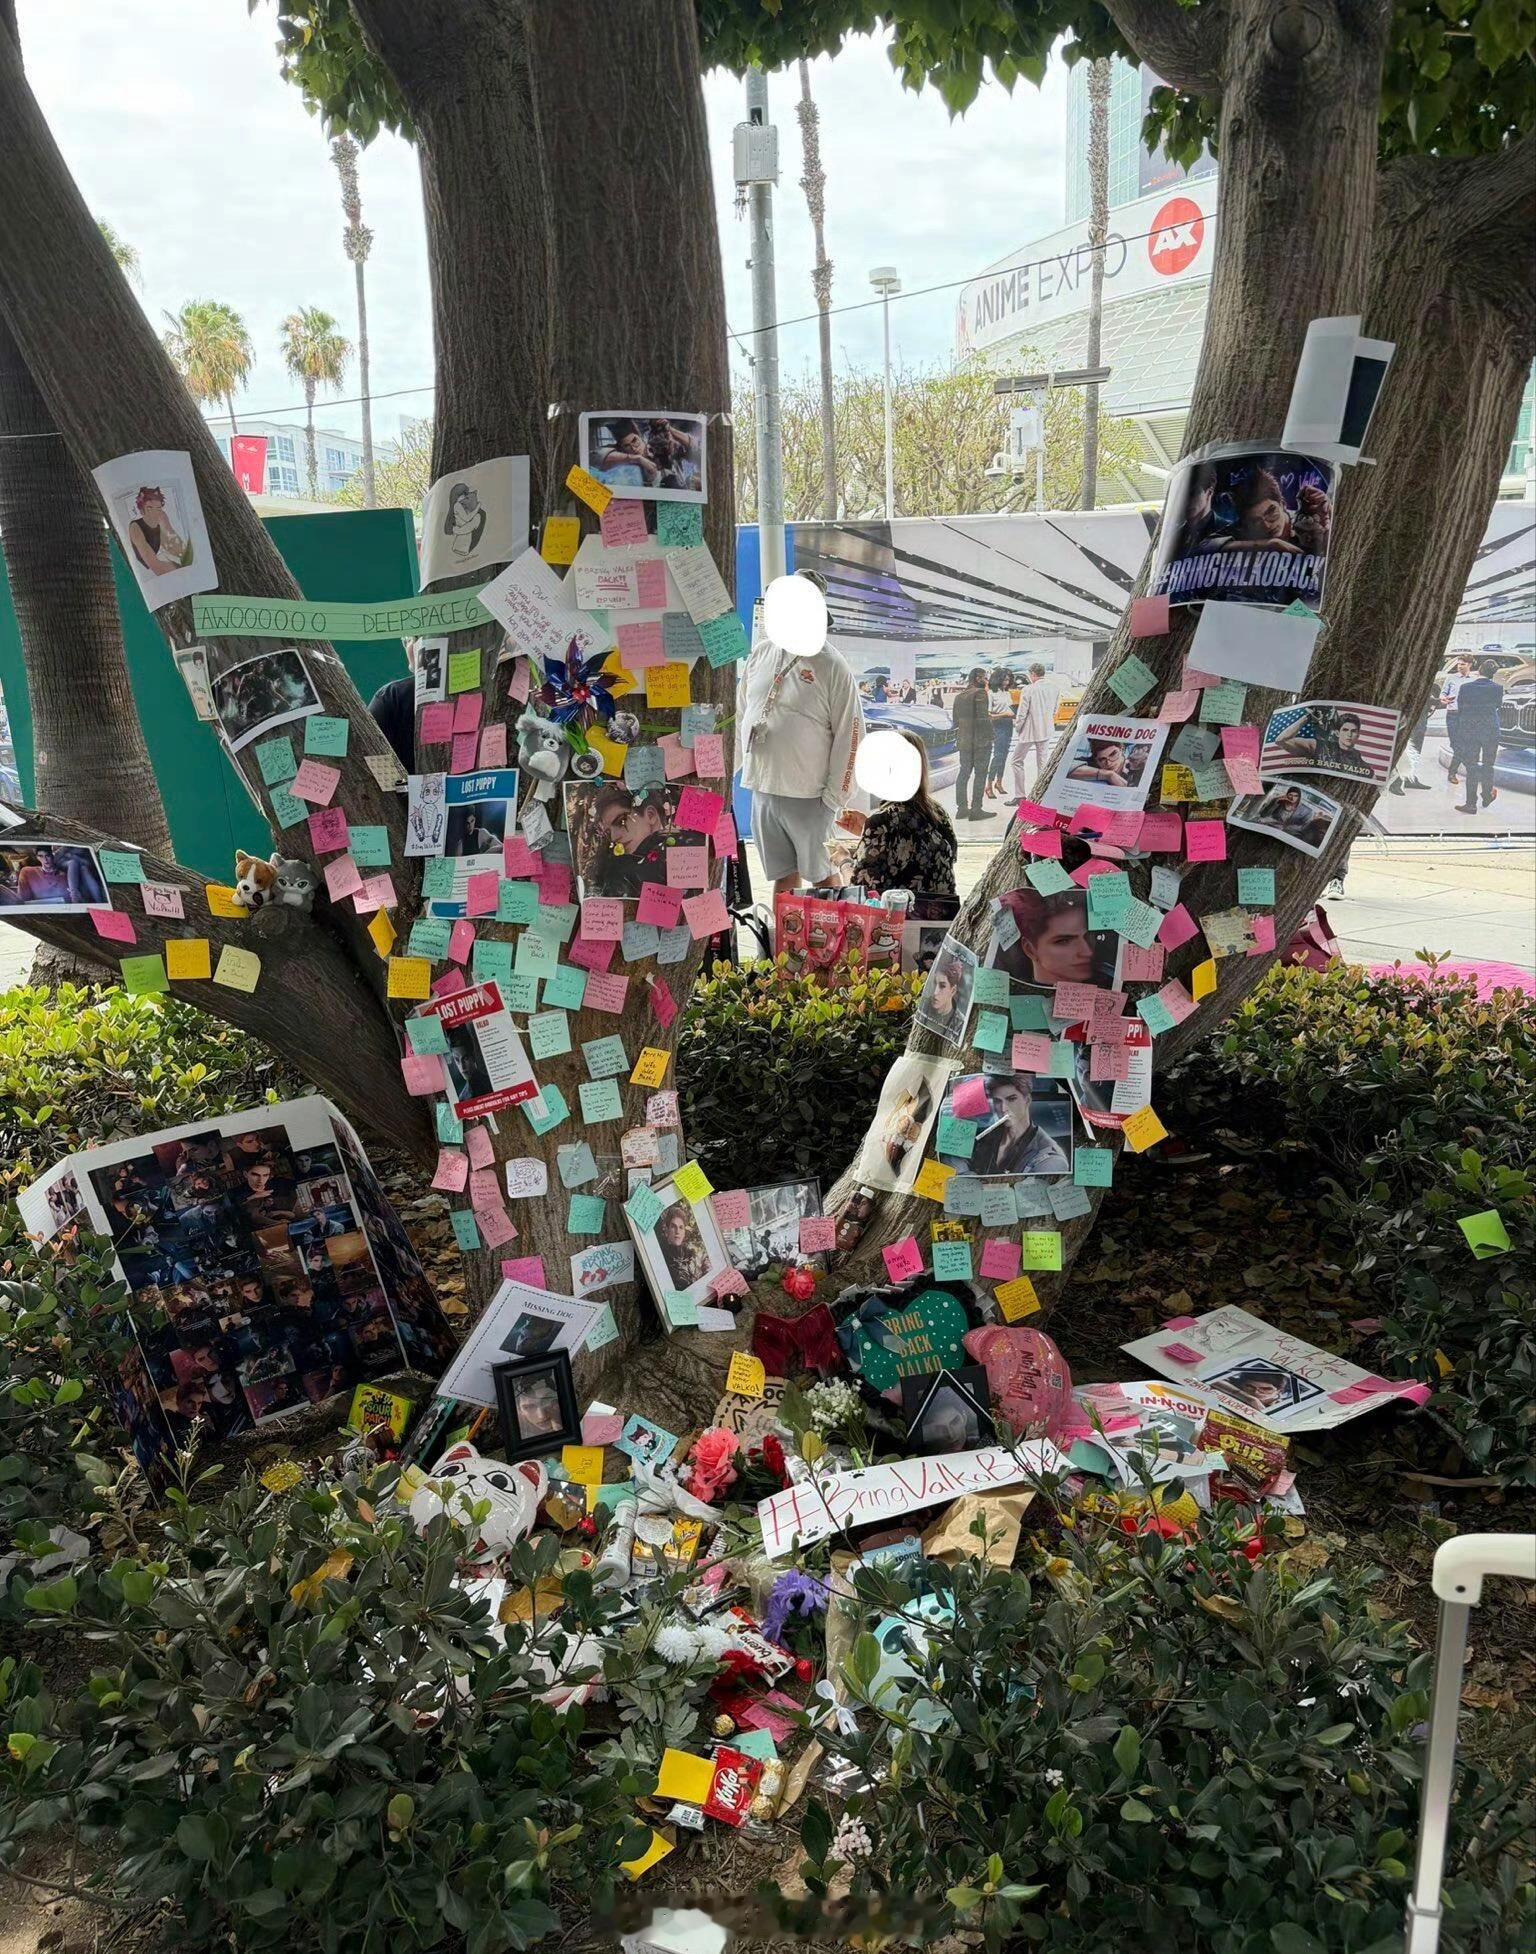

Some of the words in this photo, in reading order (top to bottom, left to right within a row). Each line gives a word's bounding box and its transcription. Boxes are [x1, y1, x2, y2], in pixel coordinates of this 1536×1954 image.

[1152, 222, 1197, 256] AX
[975, 266, 1029, 333] ANIME
[1038, 233, 1127, 301] EXPO
[1154, 551, 1326, 594] #BRINGVALKOBACK
[1086, 723, 1132, 739] MISSING
[1134, 729, 1157, 740] DOG
[1317, 759, 1341, 769] BACK
[1342, 764, 1371, 776] VALKO
[461, 779, 475, 794] LOST
[475, 776, 497, 792] PUPPY
[842, 770, 851, 792] GORGE
[436, 1001, 458, 1020] LOST
[458, 992, 486, 1014] PUPPY
[522, 1301, 556, 1314] MISSING
[557, 1309, 574, 1319] DOG
[883, 1311, 925, 1335] BRING
[1270, 1351, 1323, 1379] VALKO
[364, 1413, 391, 1427] PATCH
[367, 1402, 391, 1415] SOUR
[763, 1444, 1058, 1546] #BringValkoBack
[739, 1635, 773, 1660] bueno
